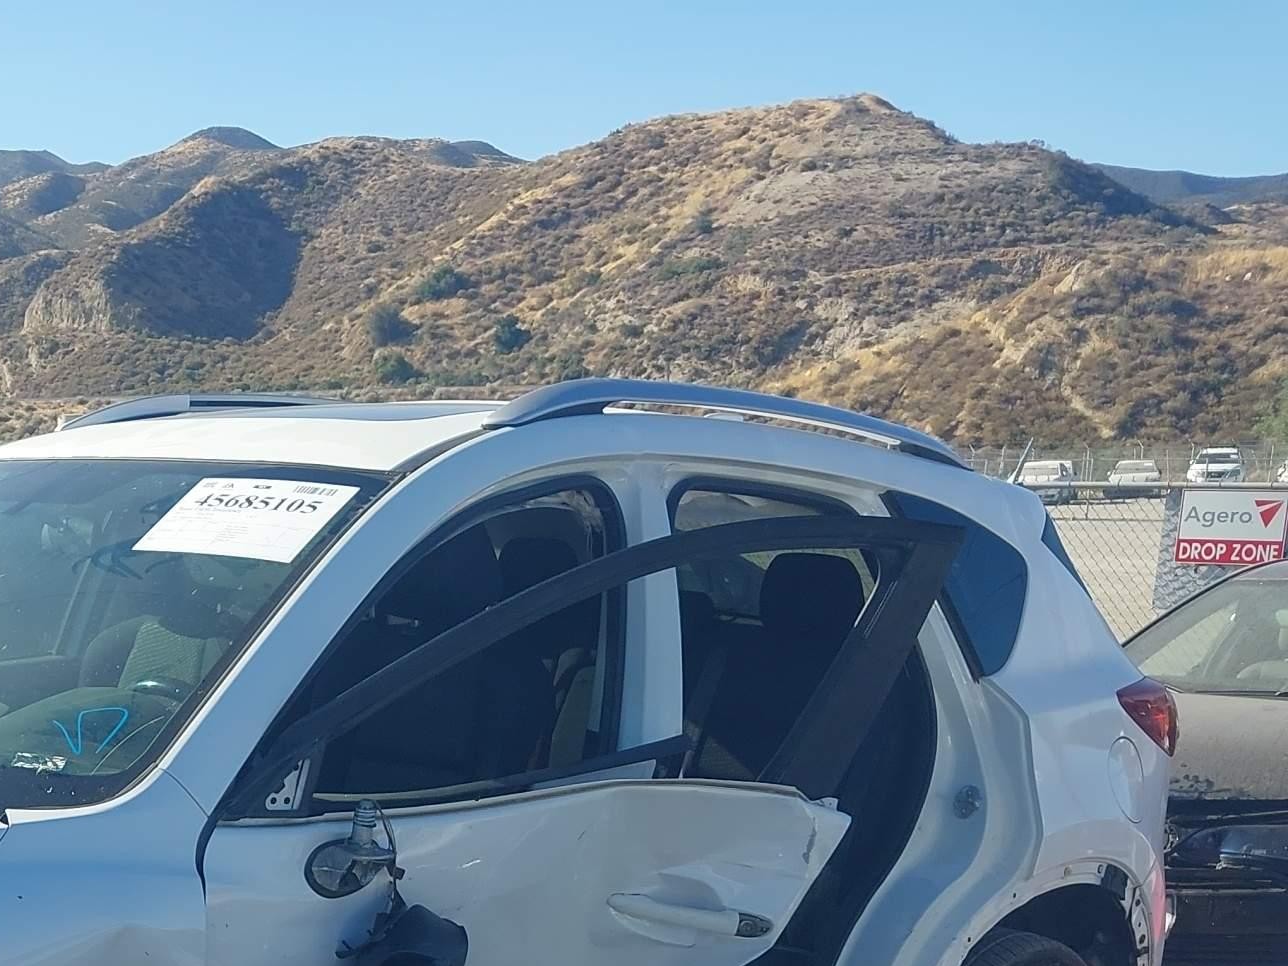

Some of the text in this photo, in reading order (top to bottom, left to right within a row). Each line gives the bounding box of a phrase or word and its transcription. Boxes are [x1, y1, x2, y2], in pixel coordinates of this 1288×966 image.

[194, 493, 324, 514] 45685105
[1184, 506, 1253, 528] Agero
[1178, 542, 1280, 562] DROP ZONE
